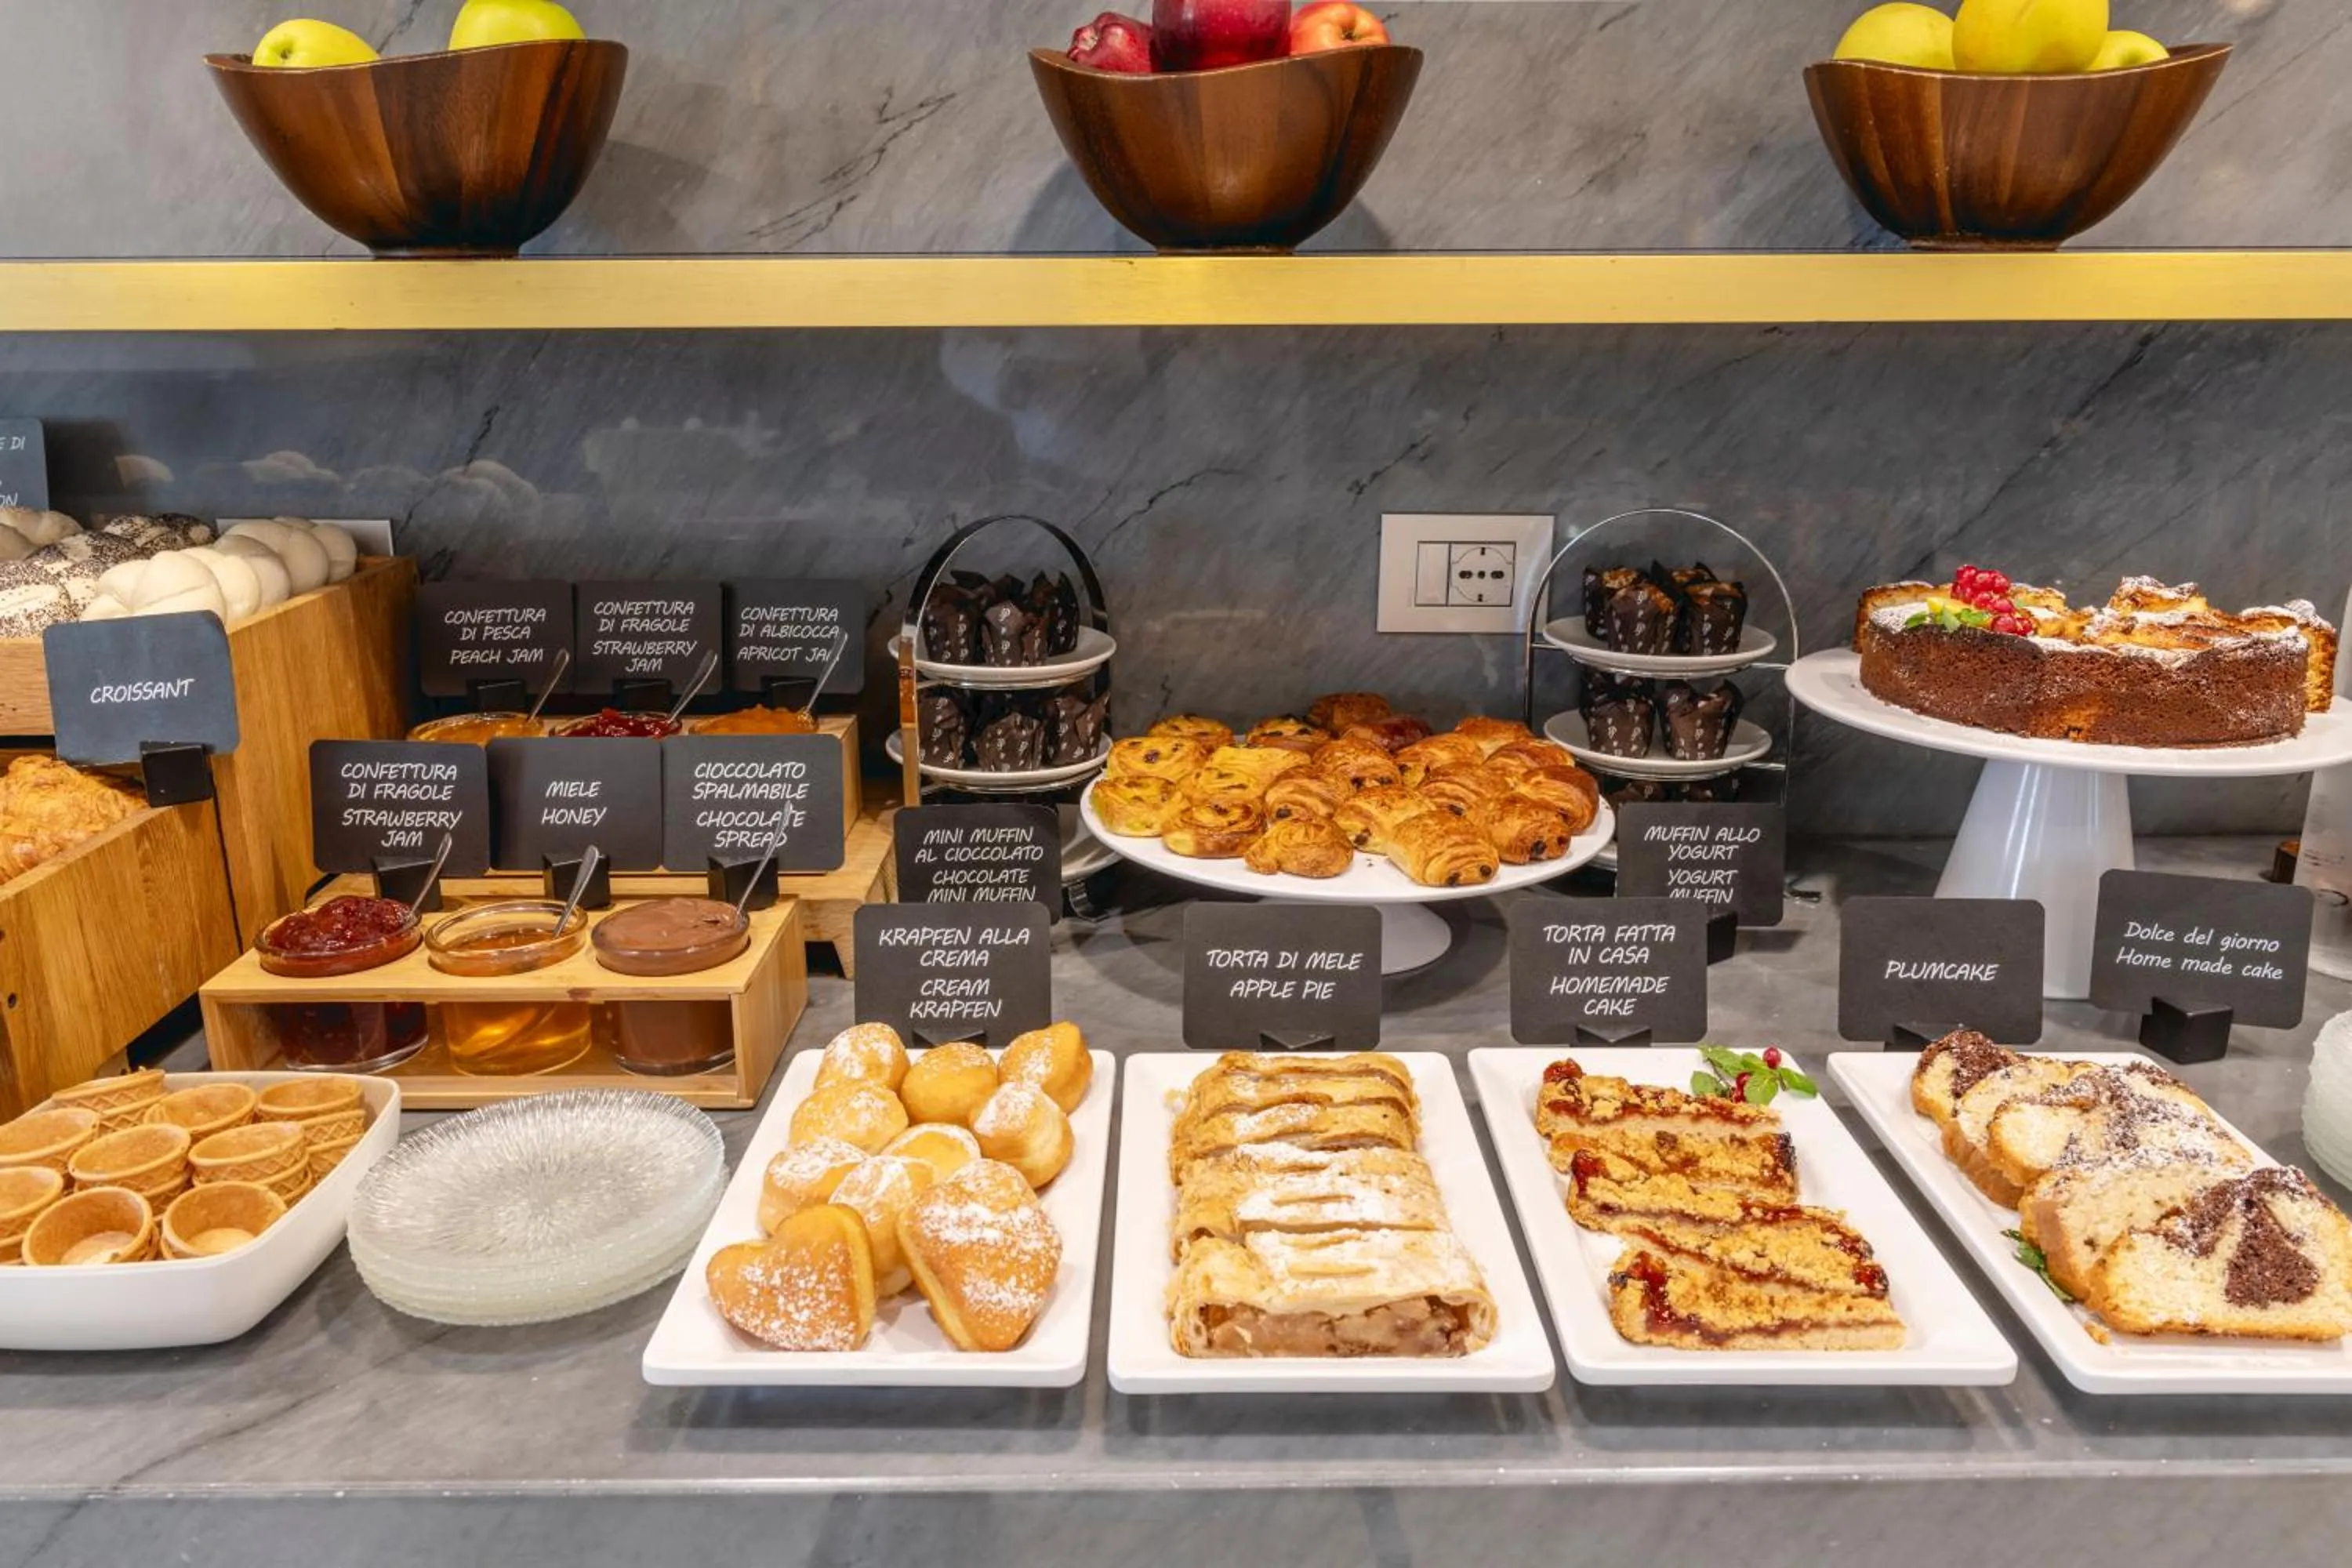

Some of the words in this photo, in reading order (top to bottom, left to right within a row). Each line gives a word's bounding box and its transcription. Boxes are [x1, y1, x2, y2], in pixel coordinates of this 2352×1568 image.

[9, 436, 26, 451] DI
[444, 608, 546, 625] CONFETTURA
[593, 600, 695, 615] CONFETTURA
[741, 606, 839, 622] CONFETTURA
[459, 626, 477, 641] DI
[482, 624, 531, 641] PESCA
[598, 618, 615, 633] DI
[620, 617, 691, 633] FRAGOLE
[739, 622, 756, 637] DI
[760, 623, 840, 639] ALBICOCCA
[449, 648, 502, 665] PEACH
[506, 648, 543, 664] JAM
[592, 640, 698, 657] STRAWBERRY
[737, 645, 803, 662] APRICOT
[805, 647, 839, 663] JA
[625, 657, 663, 673] JAM
[89, 678, 195, 704] CROISSANT
[341, 761, 458, 781] CONFETTURA
[694, 761, 806, 779] CIOCCOLATO
[347, 782, 367, 799] DI
[373, 782, 455, 801] FRAGOLE
[545, 780, 602, 798] MIELE
[691, 781, 810, 800] SPALMABILE
[342, 808, 463, 830] STRAWBERRY
[541, 807, 608, 827] HONEY
[380, 829, 423, 848] JAM
[923, 827, 964, 845] MINI
[969, 826, 1034, 844] MUFFIN
[1643, 825, 1710, 842] MUFFIN
[1715, 826, 1761, 843] ALLO
[914, 848, 938, 864] AL
[944, 844, 1044, 862] CIOCCOLATO
[1668, 843, 1740, 862] YOGURT
[932, 868, 1030, 885] CHOCOLATE
[1668, 868, 1739, 886] YOGURT
[926, 886, 967, 903] MINI
[972, 885, 1036, 903] MUFFIN
[879, 926, 971, 946] KRAPFEN
[978, 927, 1030, 946] ALLA
[1542, 924, 1606, 943] TORTA
[1614, 924, 1676, 943] FATTA
[2124, 921, 2176, 942] Dolce
[2183, 926, 2215, 946] del
[2220, 932, 2280, 953] giorno
[920, 949, 989, 967] CREMA
[1206, 949, 1269, 968] TORTA
[1276, 951, 1299, 970] DI
[1305, 951, 1363, 971] MELE
[1567, 945, 1592, 965] IN
[1599, 945, 1650, 965] CASA
[2115, 946, 2172, 969] Home
[2180, 956, 2233, 975] made
[2241, 961, 2283, 980] cake
[1884, 960, 2000, 982] PLUMCAKE
[920, 978, 990, 996] CREAM
[1229, 978, 1297, 999] APPLE
[1301, 979, 1337, 1000] PIE
[1549, 975, 1671, 995] HOMEMADE
[909, 998, 1003, 1019] KRAPFEN
[1584, 998, 1638, 1016] CAKE
